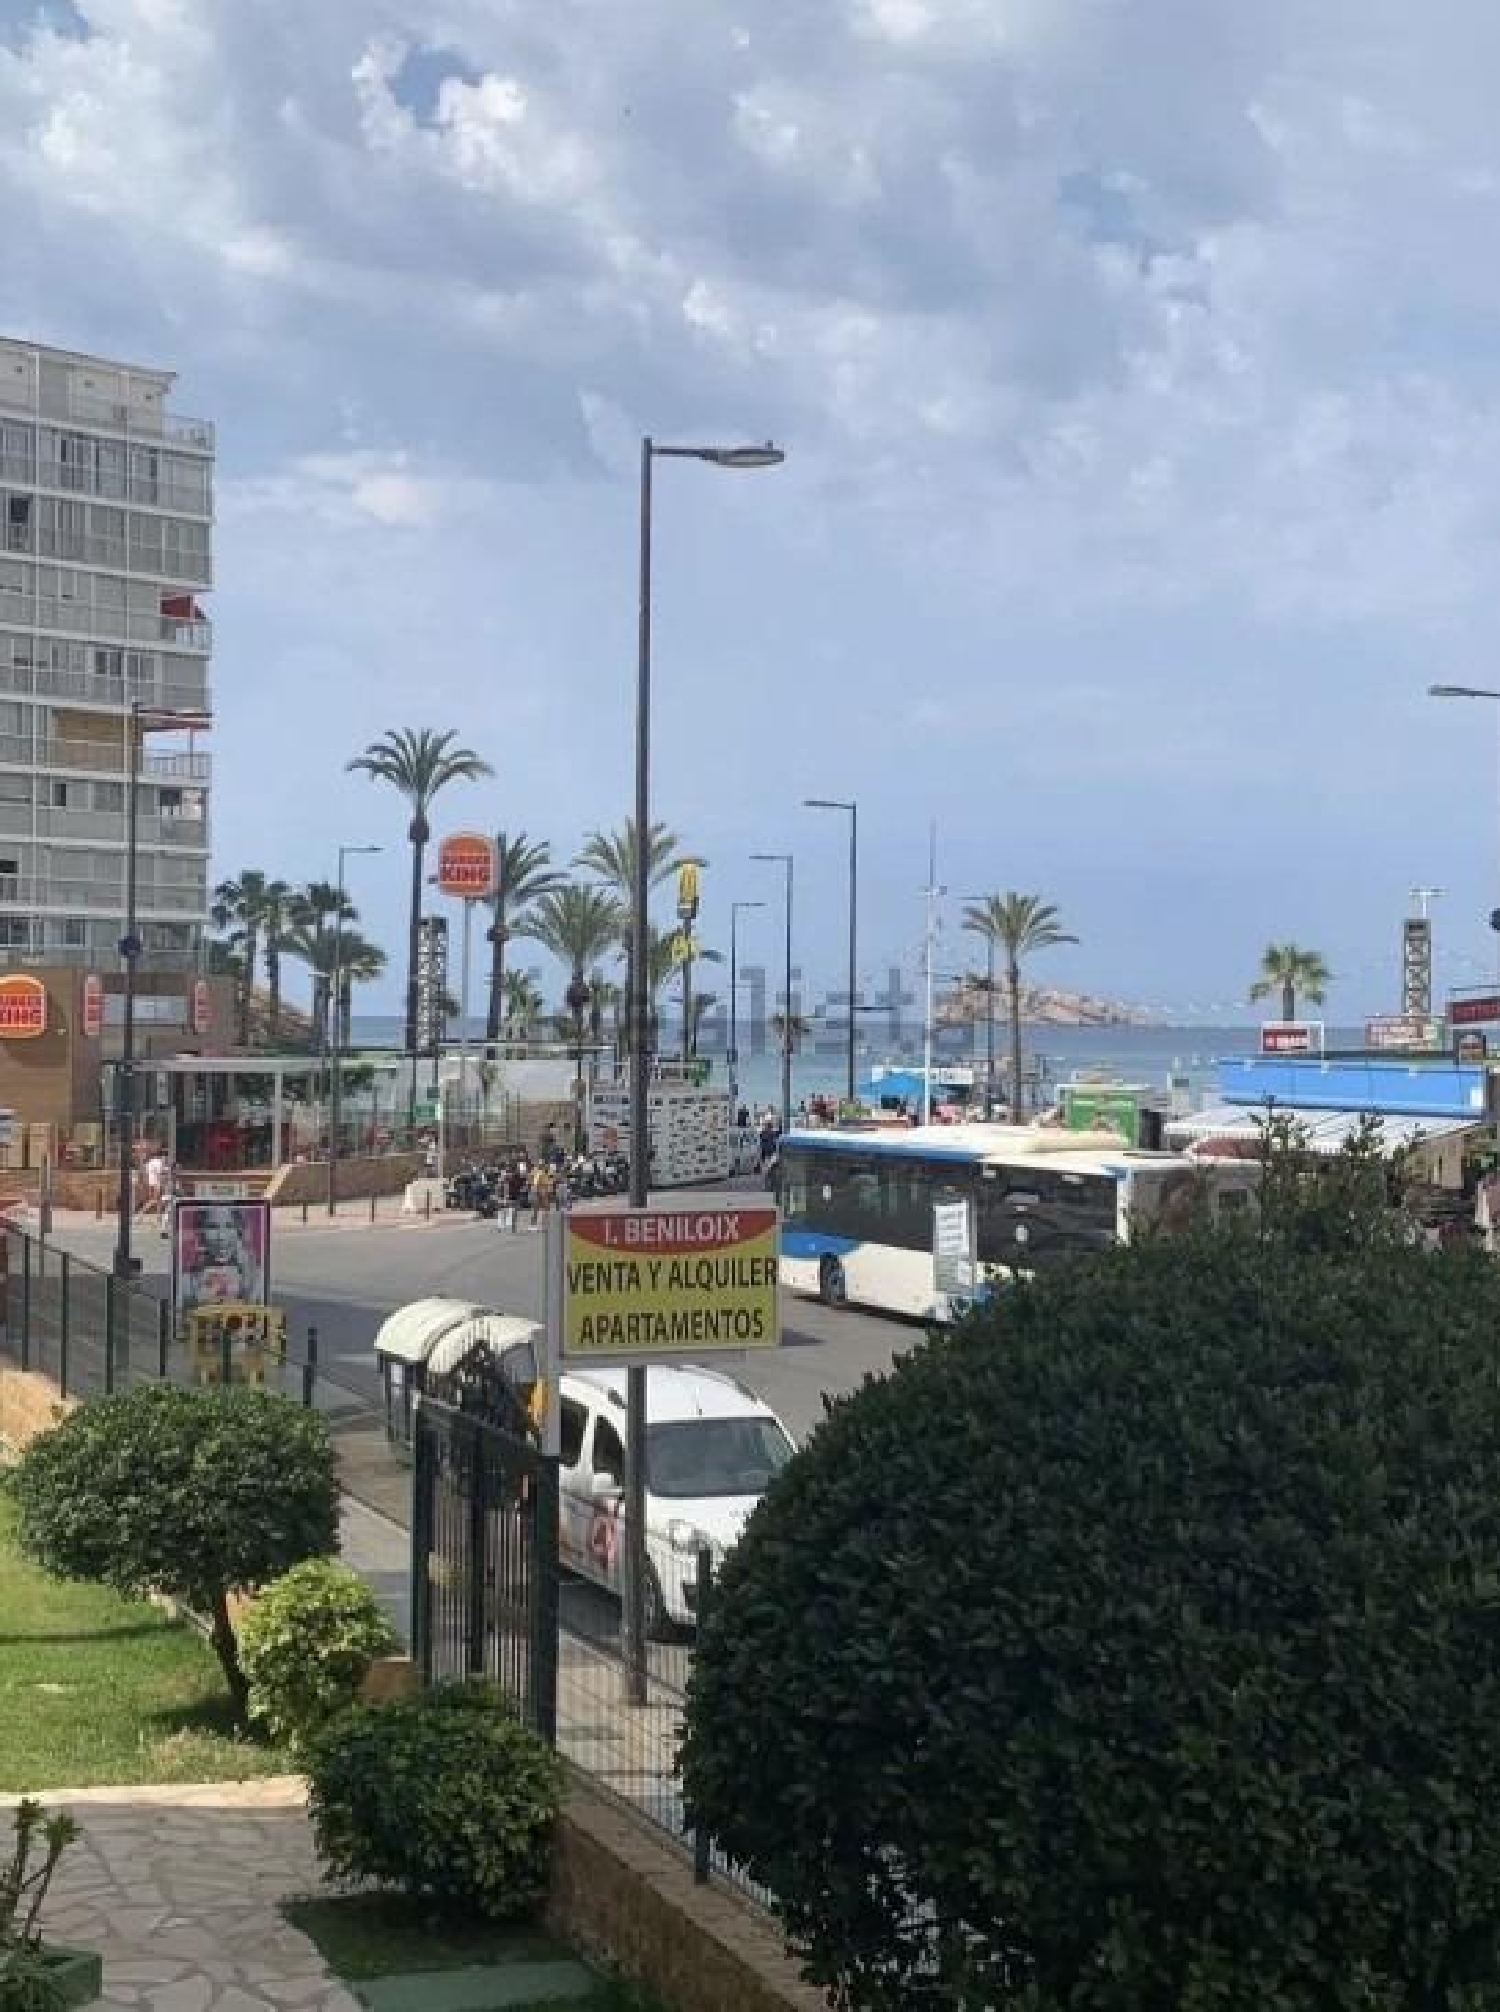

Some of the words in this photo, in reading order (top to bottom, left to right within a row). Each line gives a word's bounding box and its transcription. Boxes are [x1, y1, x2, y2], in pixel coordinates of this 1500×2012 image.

[442, 865, 491, 882] KING
[624, 1213, 739, 1243] BENILOIX
[567, 1259, 641, 1295] VENTA
[648, 1258, 662, 1292] Y
[668, 1256, 777, 1291] ALQUILER
[580, 1307, 764, 1344] APARTAMENTOS
